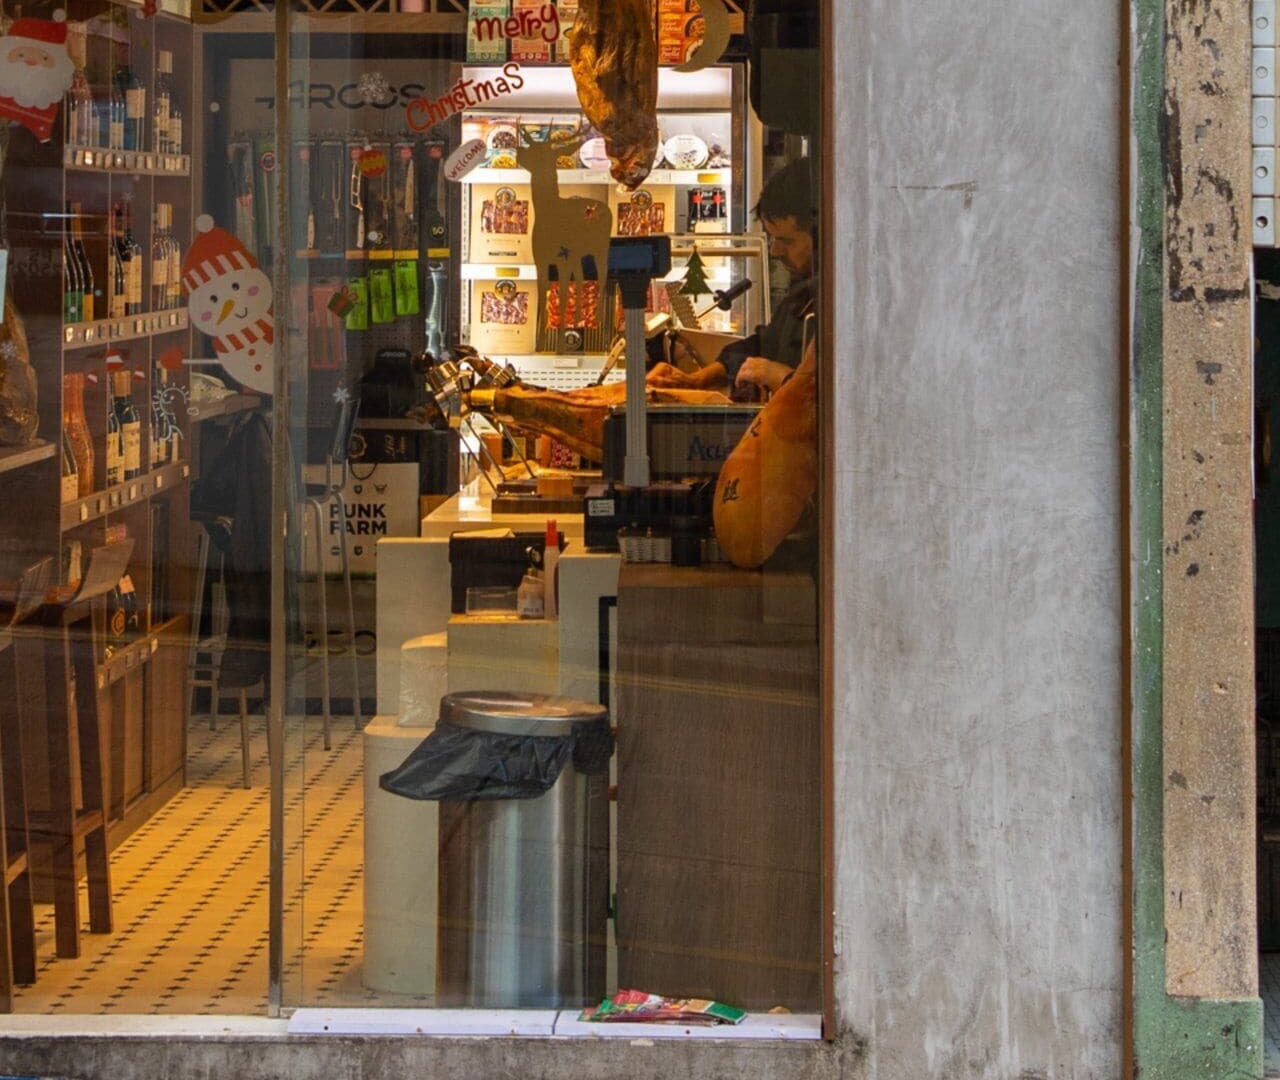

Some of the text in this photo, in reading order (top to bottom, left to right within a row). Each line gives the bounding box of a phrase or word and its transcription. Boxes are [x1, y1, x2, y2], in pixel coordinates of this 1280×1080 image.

[475, 3, 561, 43] merry
[329, 503, 387, 518] PUNK
[329, 519, 388, 536] FARM
